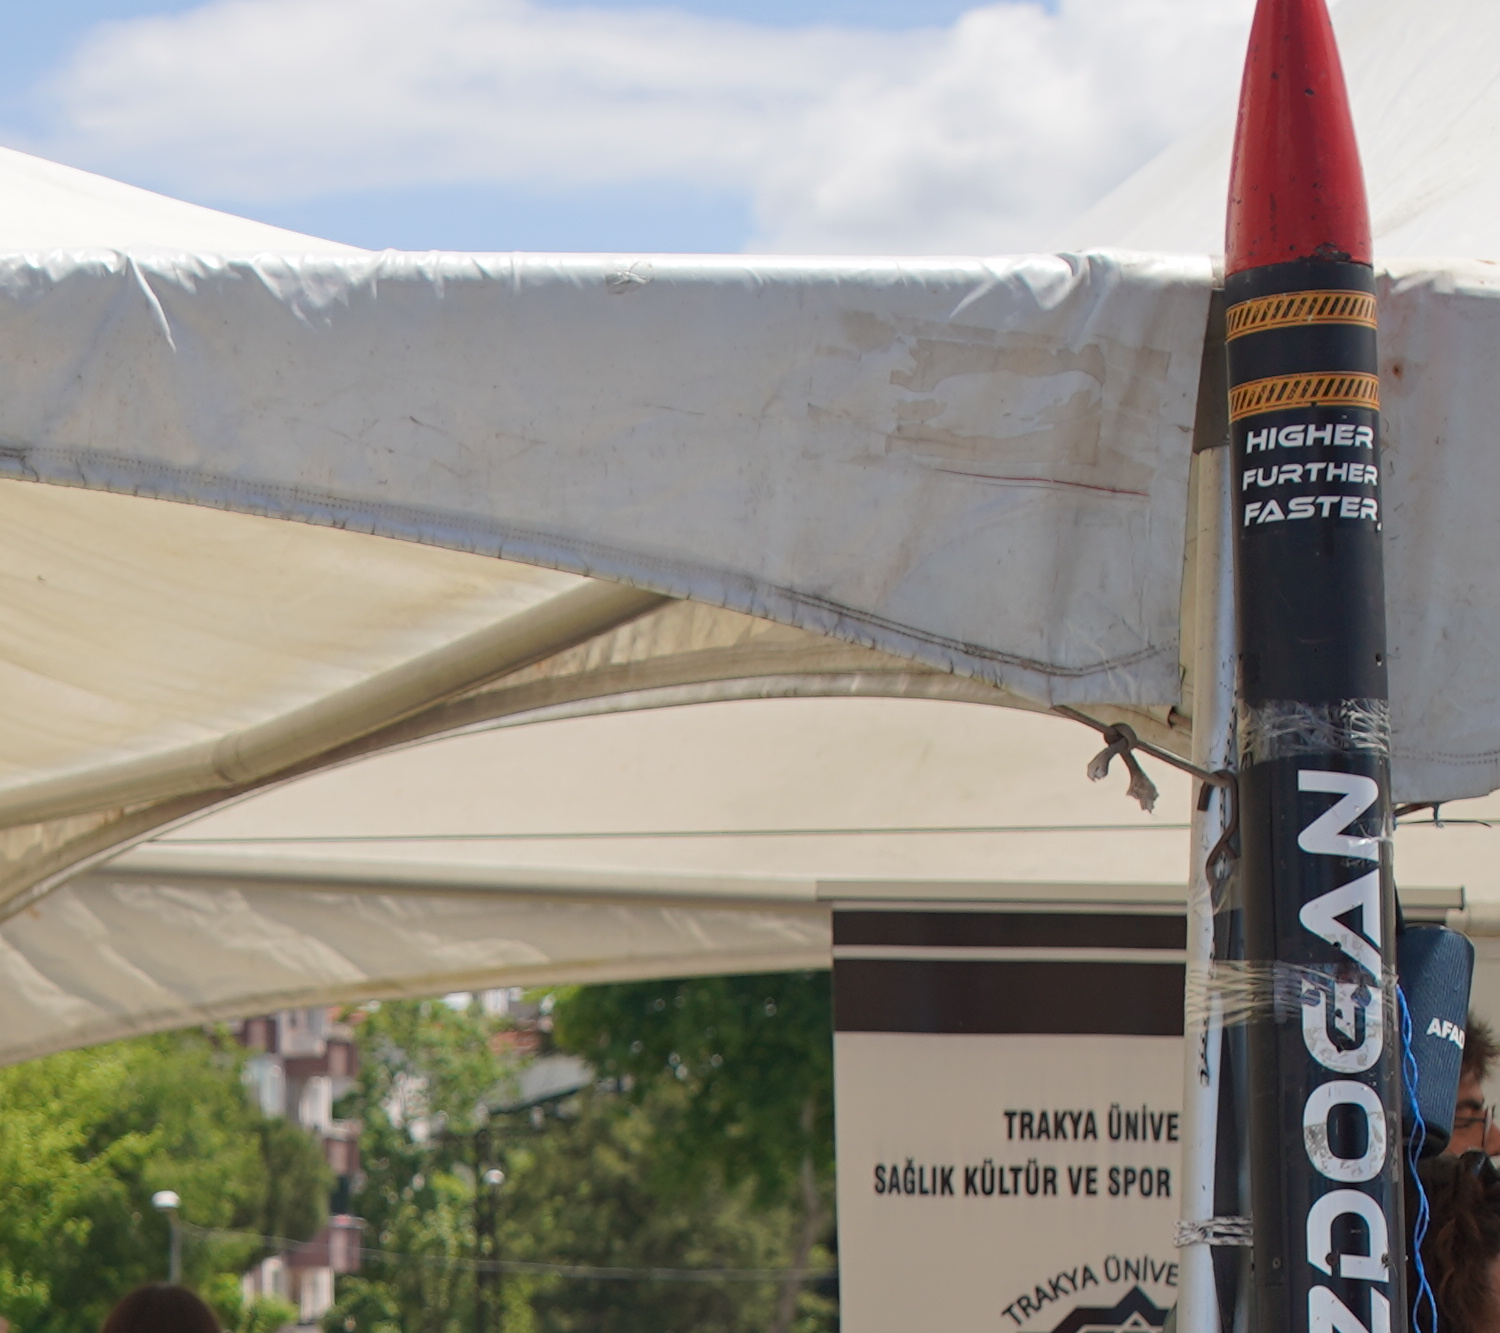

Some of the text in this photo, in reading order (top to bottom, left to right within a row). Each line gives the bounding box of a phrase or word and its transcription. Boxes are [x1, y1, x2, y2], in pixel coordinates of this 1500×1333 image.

[1246, 423, 1374, 454] HIGHER
[1242, 462, 1378, 492] FURTHER
[1243, 495, 1378, 527] FASTER
[1004, 1103, 1179, 1141] TRAKYA ÜNİVE
[875, 1158, 1171, 1198] SAĞLIK KÜLTÜR VE SPOR
[1001, 1254, 1179, 1327] TRAKYA ÜNİVE
